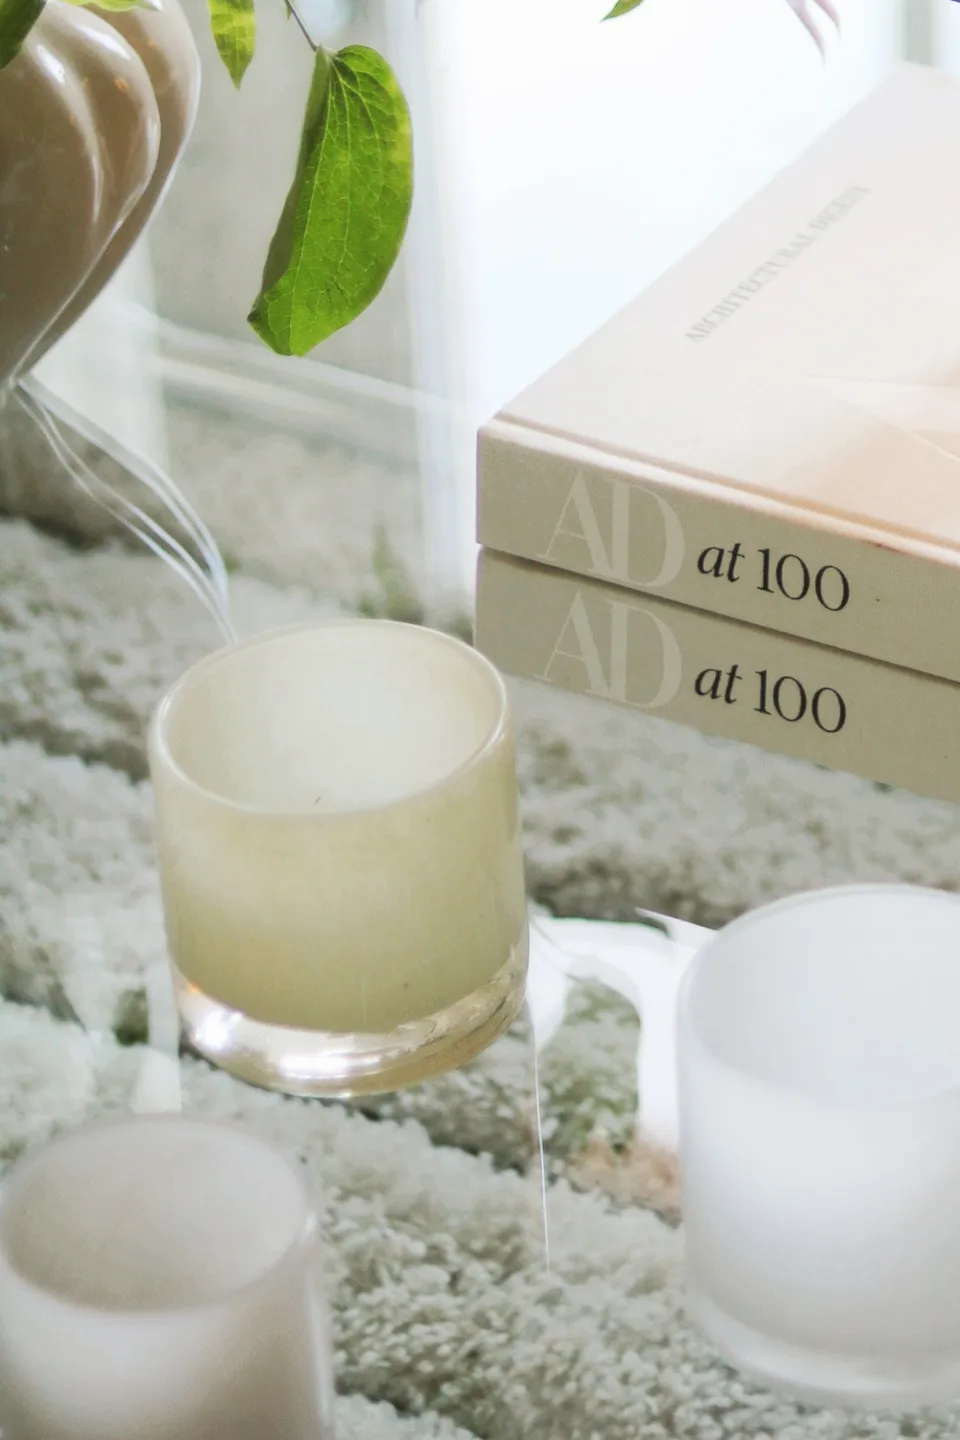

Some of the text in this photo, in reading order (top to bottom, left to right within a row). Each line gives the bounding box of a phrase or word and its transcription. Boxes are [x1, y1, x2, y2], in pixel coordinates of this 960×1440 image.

[536, 470, 851, 612] AD at 100
[532, 590, 847, 733] AD at 100
